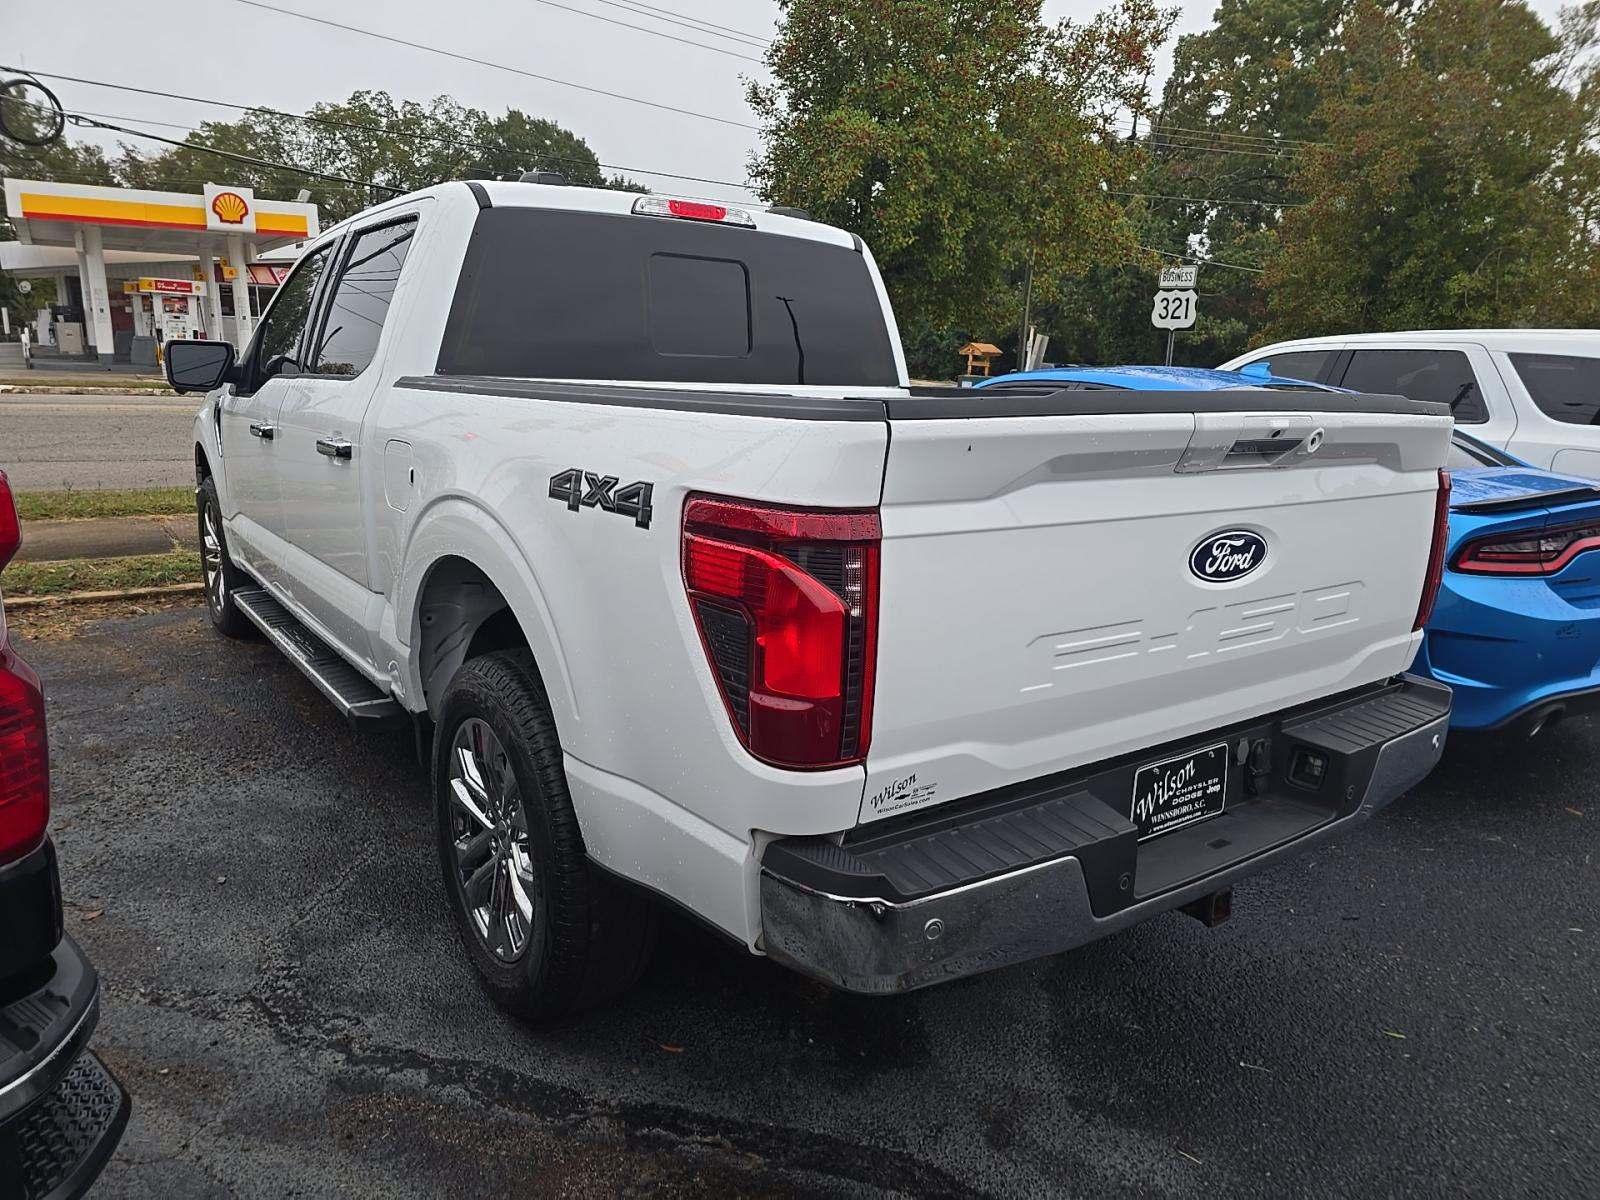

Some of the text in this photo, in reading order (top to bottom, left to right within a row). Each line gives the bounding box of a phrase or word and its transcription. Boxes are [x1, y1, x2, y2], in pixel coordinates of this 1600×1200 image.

[1162, 271, 1193, 282] BUSINESS
[1158, 297, 1190, 320] 321
[1205, 537, 1256, 574] Ford
[1020, 580, 1366, 692] F-150
[870, 773, 917, 809] Wilson
[1136, 759, 1196, 822] Wilson
[1172, 783, 1221, 806] DODGE Jeep
[1176, 777, 1219, 796] CHRYSLER
